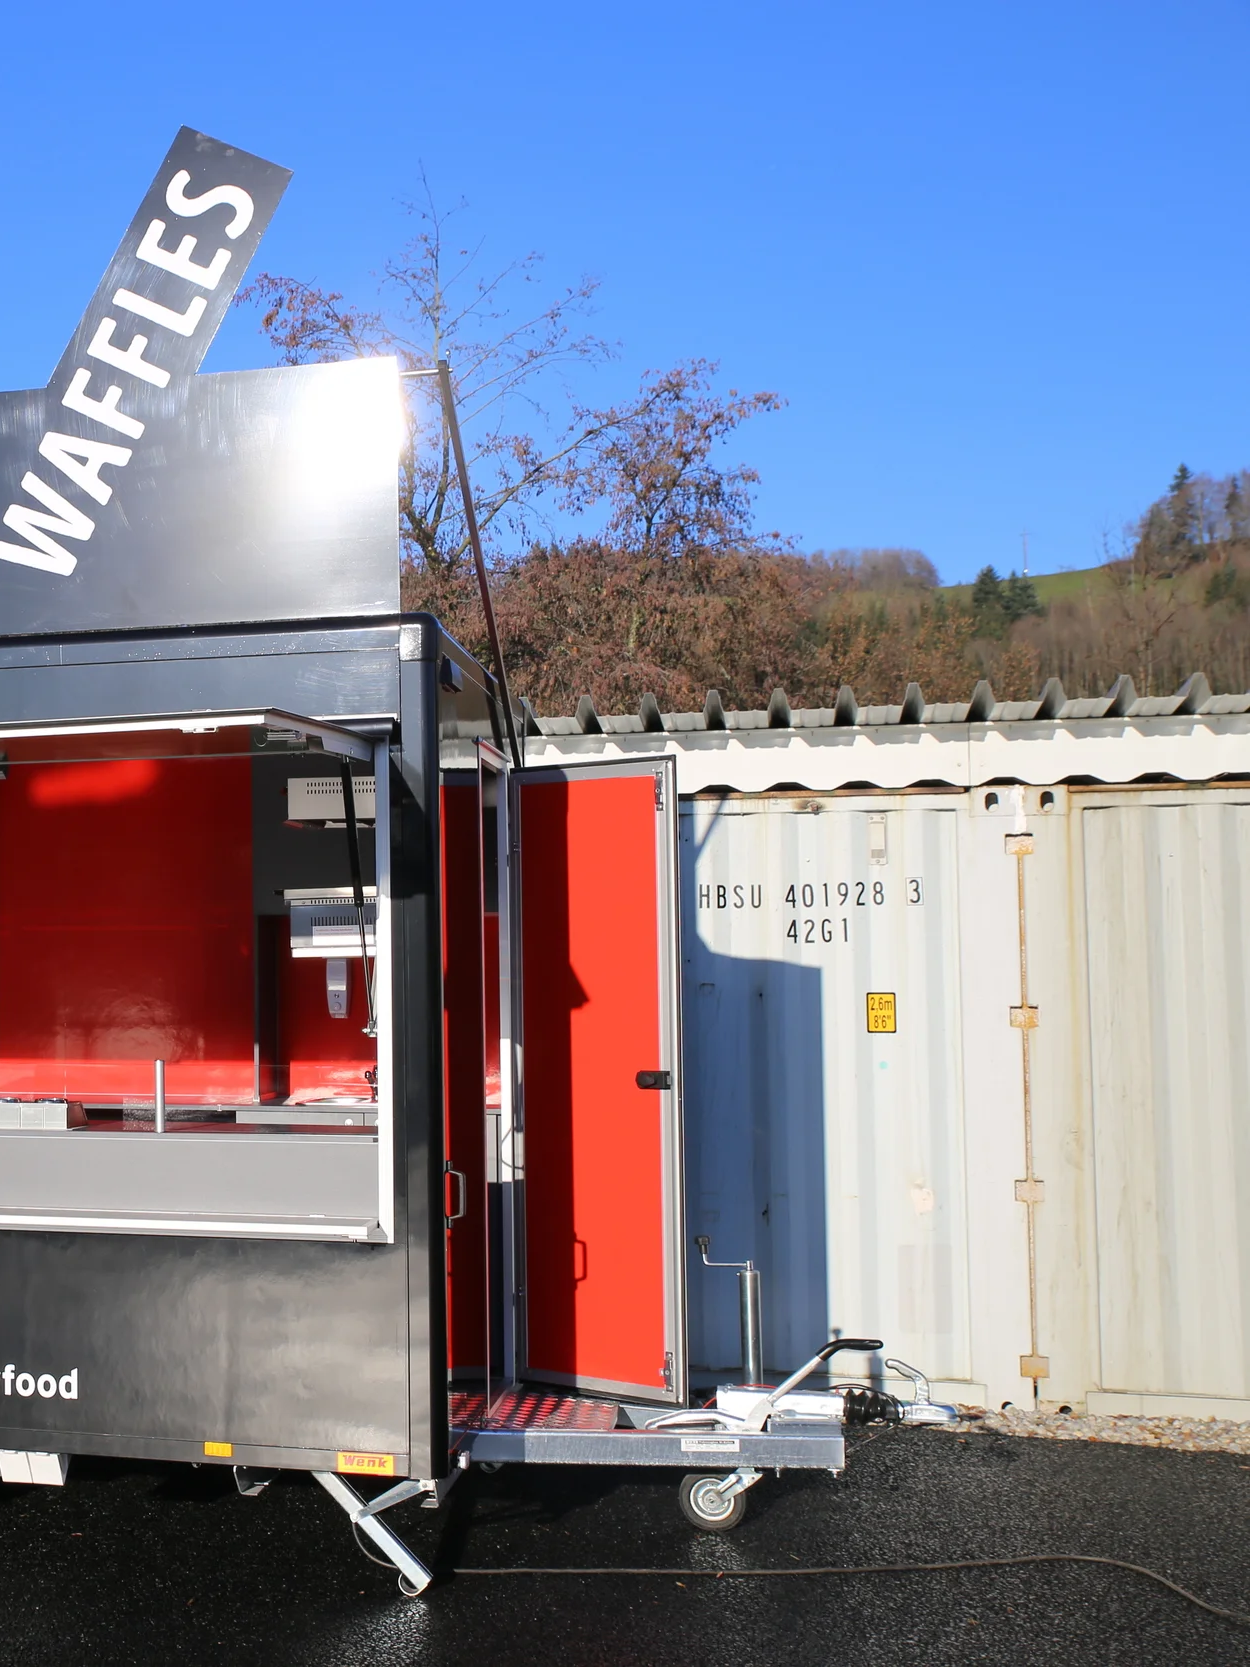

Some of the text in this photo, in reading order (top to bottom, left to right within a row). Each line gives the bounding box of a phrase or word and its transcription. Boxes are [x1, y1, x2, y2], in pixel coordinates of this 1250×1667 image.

[698, 878, 923, 909] HBSU 401928 3
[786, 917, 849, 944] 42G1
